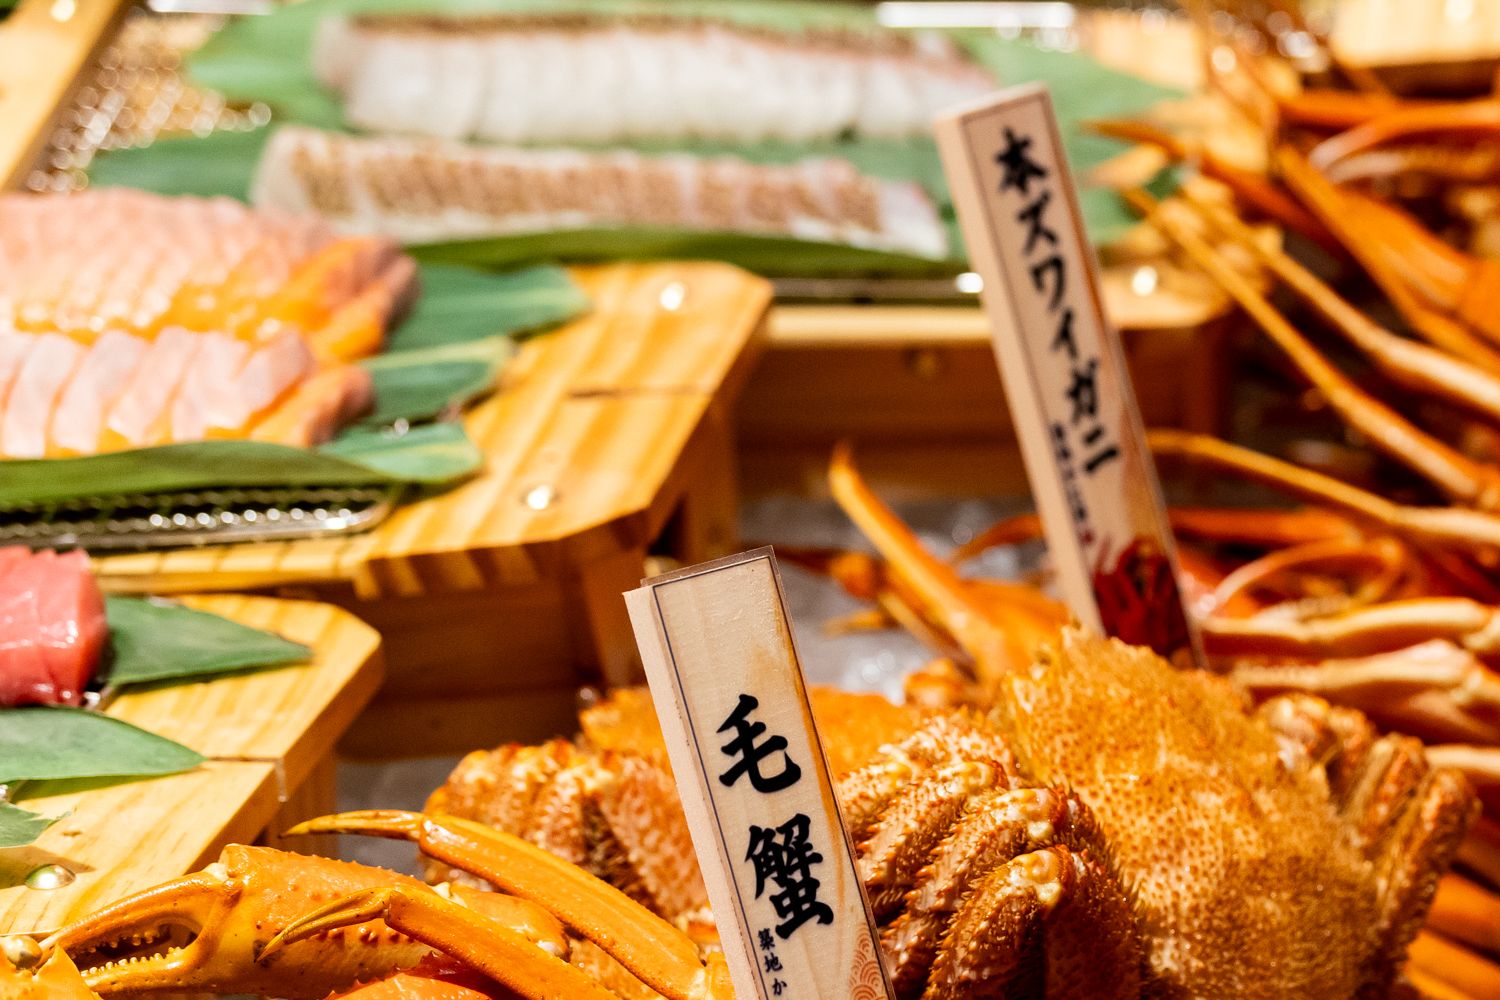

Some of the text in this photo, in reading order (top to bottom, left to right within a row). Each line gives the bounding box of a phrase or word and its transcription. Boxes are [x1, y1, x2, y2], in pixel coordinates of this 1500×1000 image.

[995, 127, 1119, 473] 本ズワイガニ
[715, 694, 834, 940] 毛蟹
